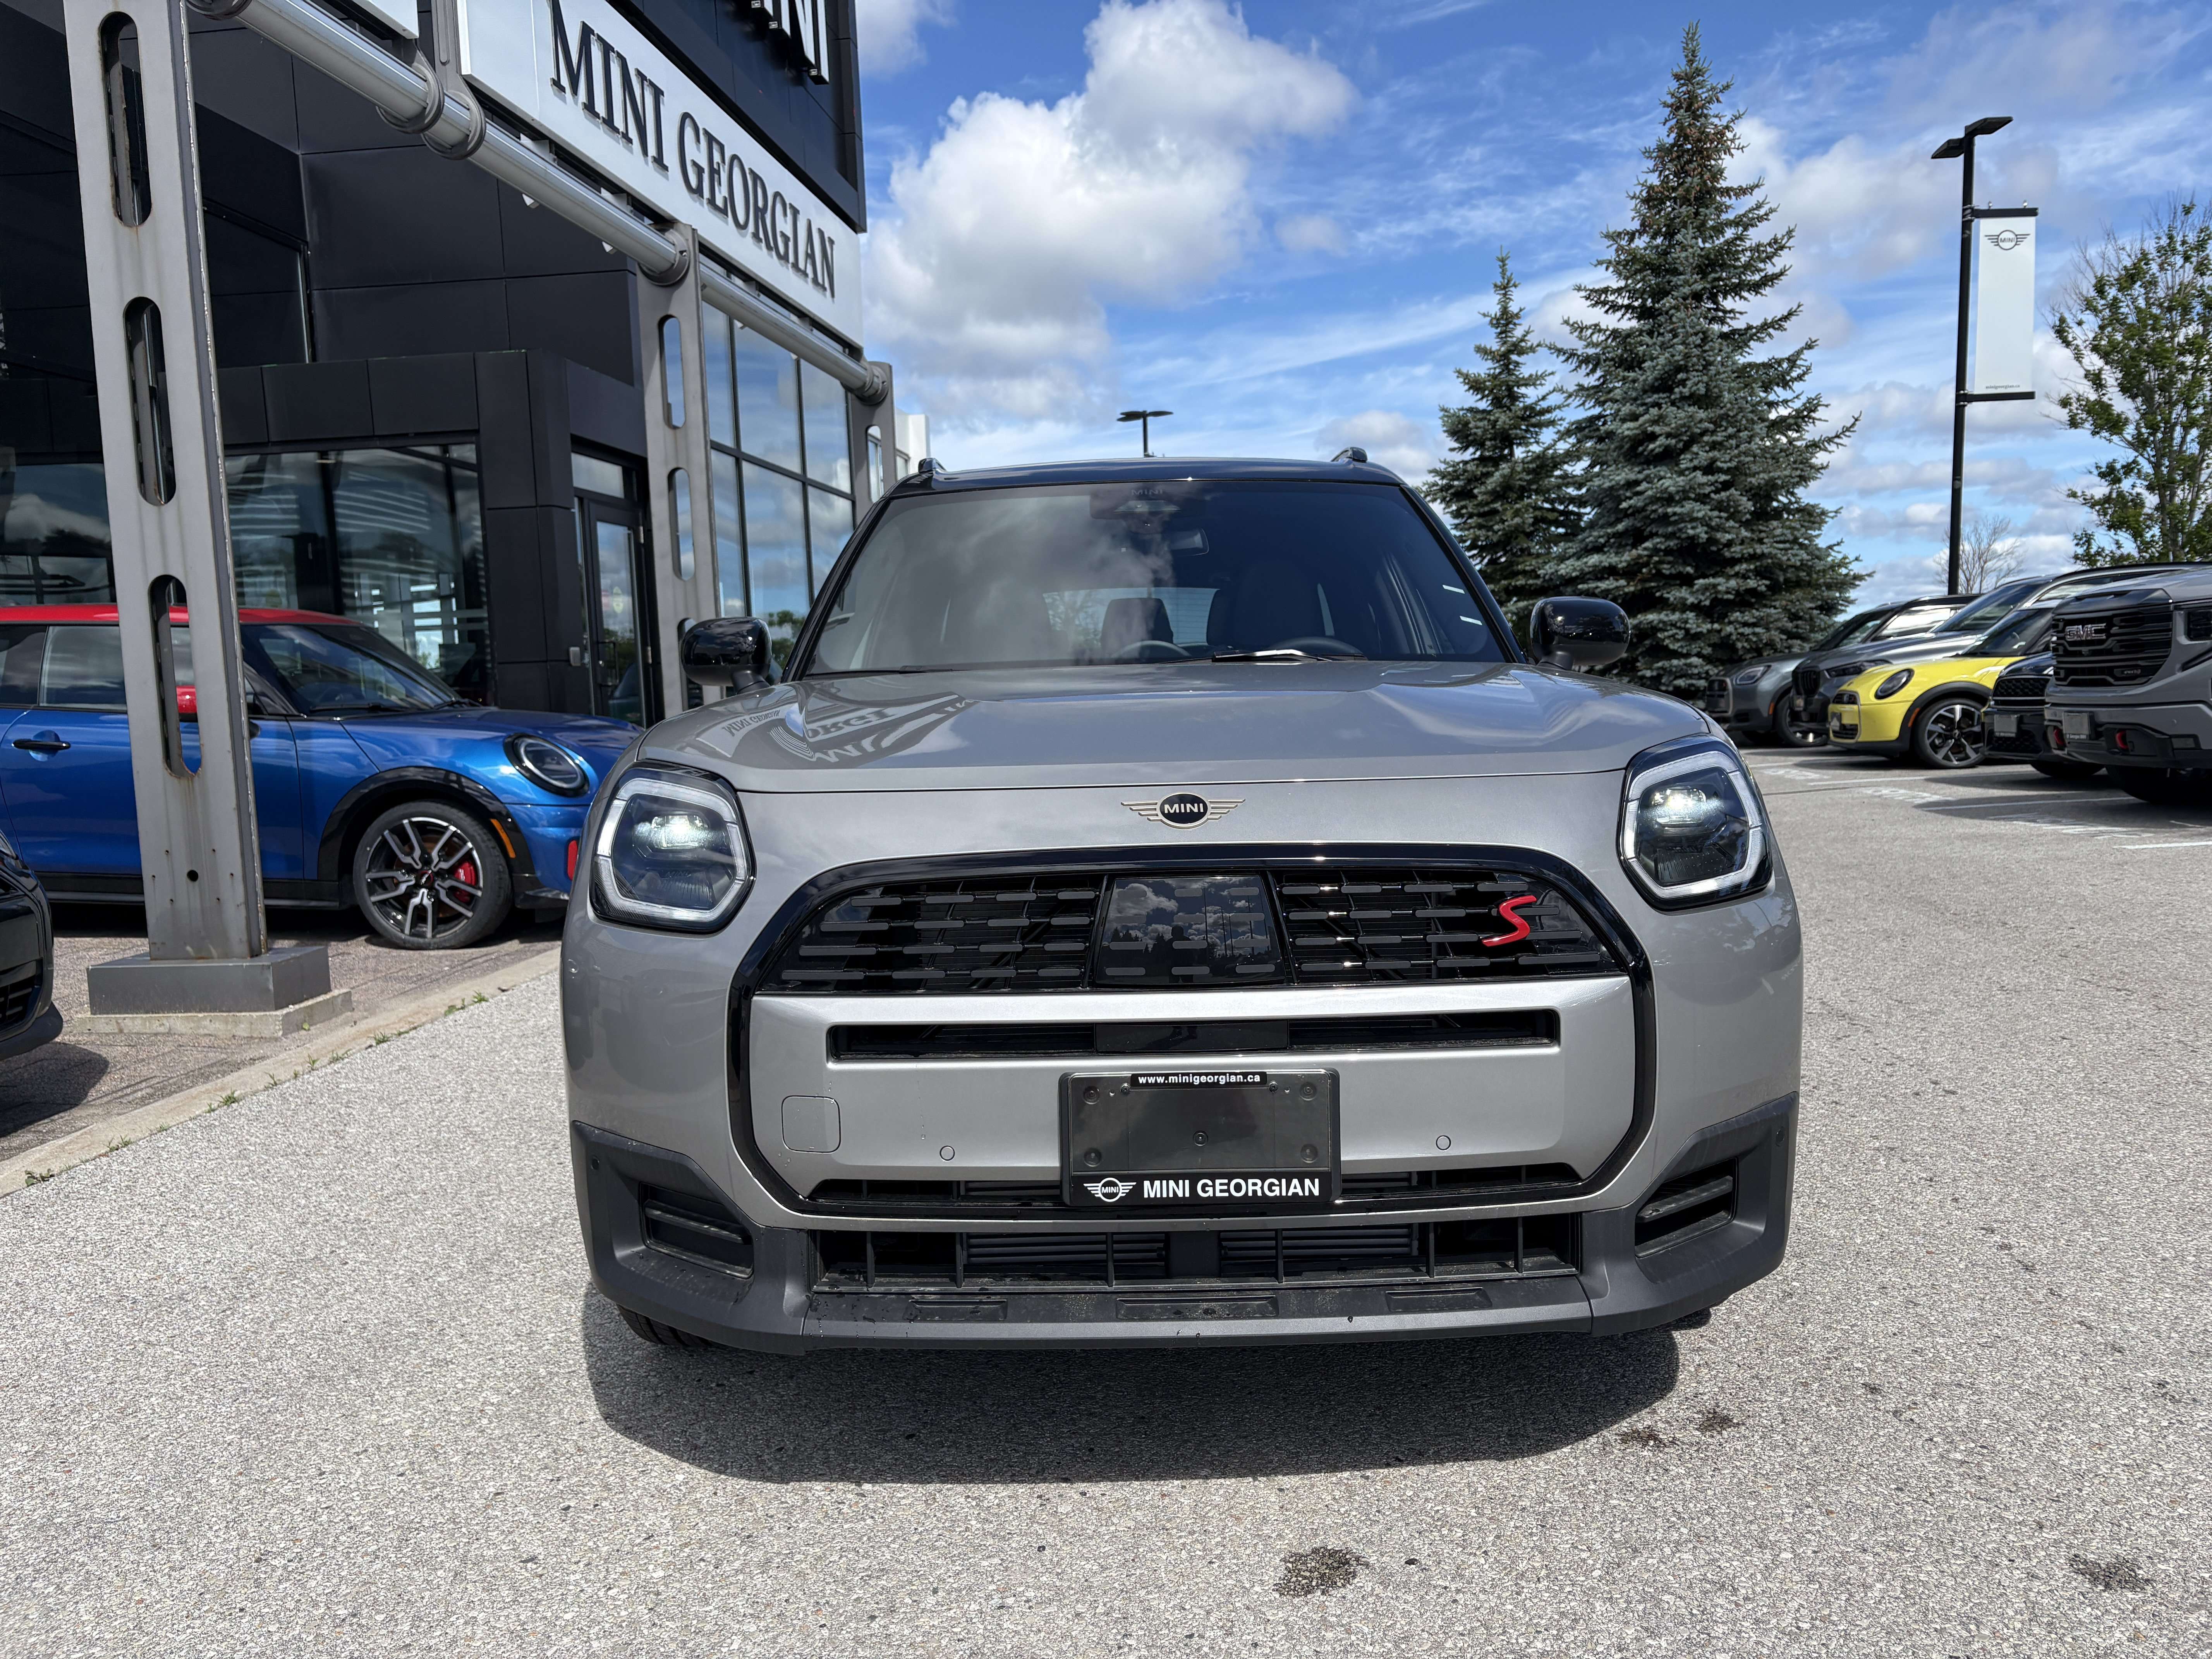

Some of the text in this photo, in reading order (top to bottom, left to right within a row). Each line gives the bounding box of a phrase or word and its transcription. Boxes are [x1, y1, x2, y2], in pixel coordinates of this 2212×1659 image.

[549, 0, 836, 299] MINI GEORGIAN
[2065, 623, 2106, 641] GMC
[1164, 803, 1204, 814] MINI
[1481, 895, 1537, 947] S
[1138, 1073, 1261, 1085] www.minigeorgian.ca
[1101, 1185, 1120, 1194] MINI
[1143, 1178, 1319, 1198] MINI GEORGIAN
